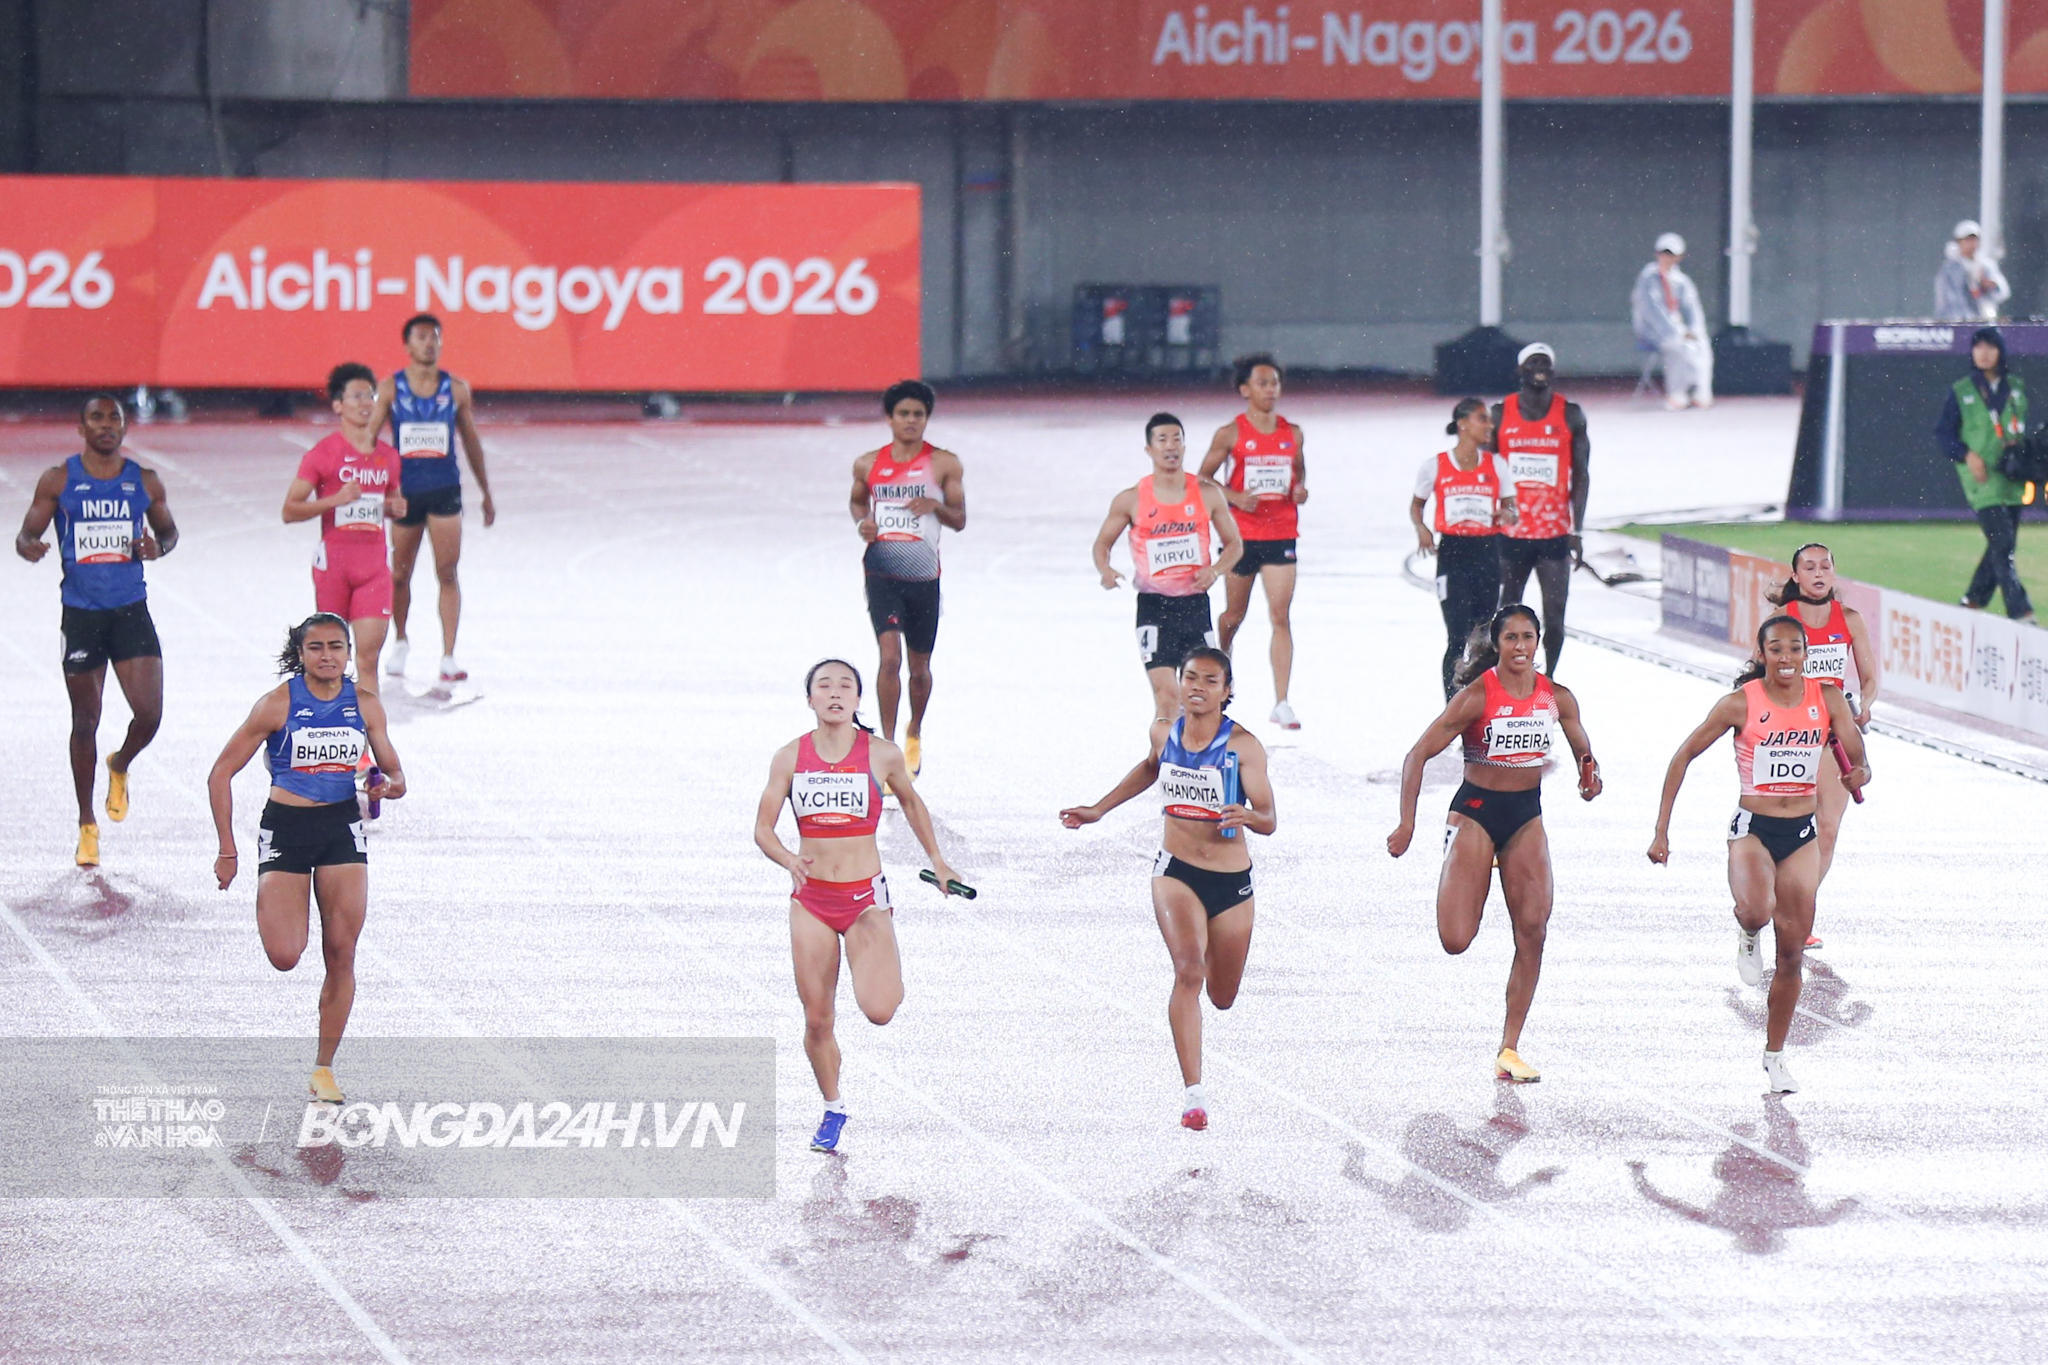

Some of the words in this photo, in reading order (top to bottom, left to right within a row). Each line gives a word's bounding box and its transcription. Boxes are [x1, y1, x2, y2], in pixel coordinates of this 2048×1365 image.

[1551, 10, 1692, 64] 2026
[196, 246, 684, 331] Aichi-Nagoya
[703, 256, 879, 316] 2026
[339, 465, 389, 486] CHINA
[873, 484, 926, 499] SINGAPORE
[82, 499, 131, 519] INDIA
[878, 515, 920, 529] LOUIS
[1150, 521, 1196, 534] JAPAN
[79, 535, 130, 549] KUJUR
[1154, 547, 1194, 564] KIRYU
[1140, 629, 1150, 650] 4
[1807, 647, 1838, 655] ORNAN
[1506, 720, 1545, 729] BORNAN
[307, 730, 350, 739] BORNAN
[1495, 733, 1551, 749] PEREIRA
[1760, 728, 1822, 747] JAPAN
[297, 743, 359, 761] BHADRA
[1768, 750, 1811, 758] BORNAN
[1170, 769, 1208, 781] BORNAN
[1770, 763, 1806, 778] IDO
[808, 777, 853, 785] BORNAN
[798, 791, 864, 808] Y.CHEN
[1161, 781, 1219, 803] KHANONTA
